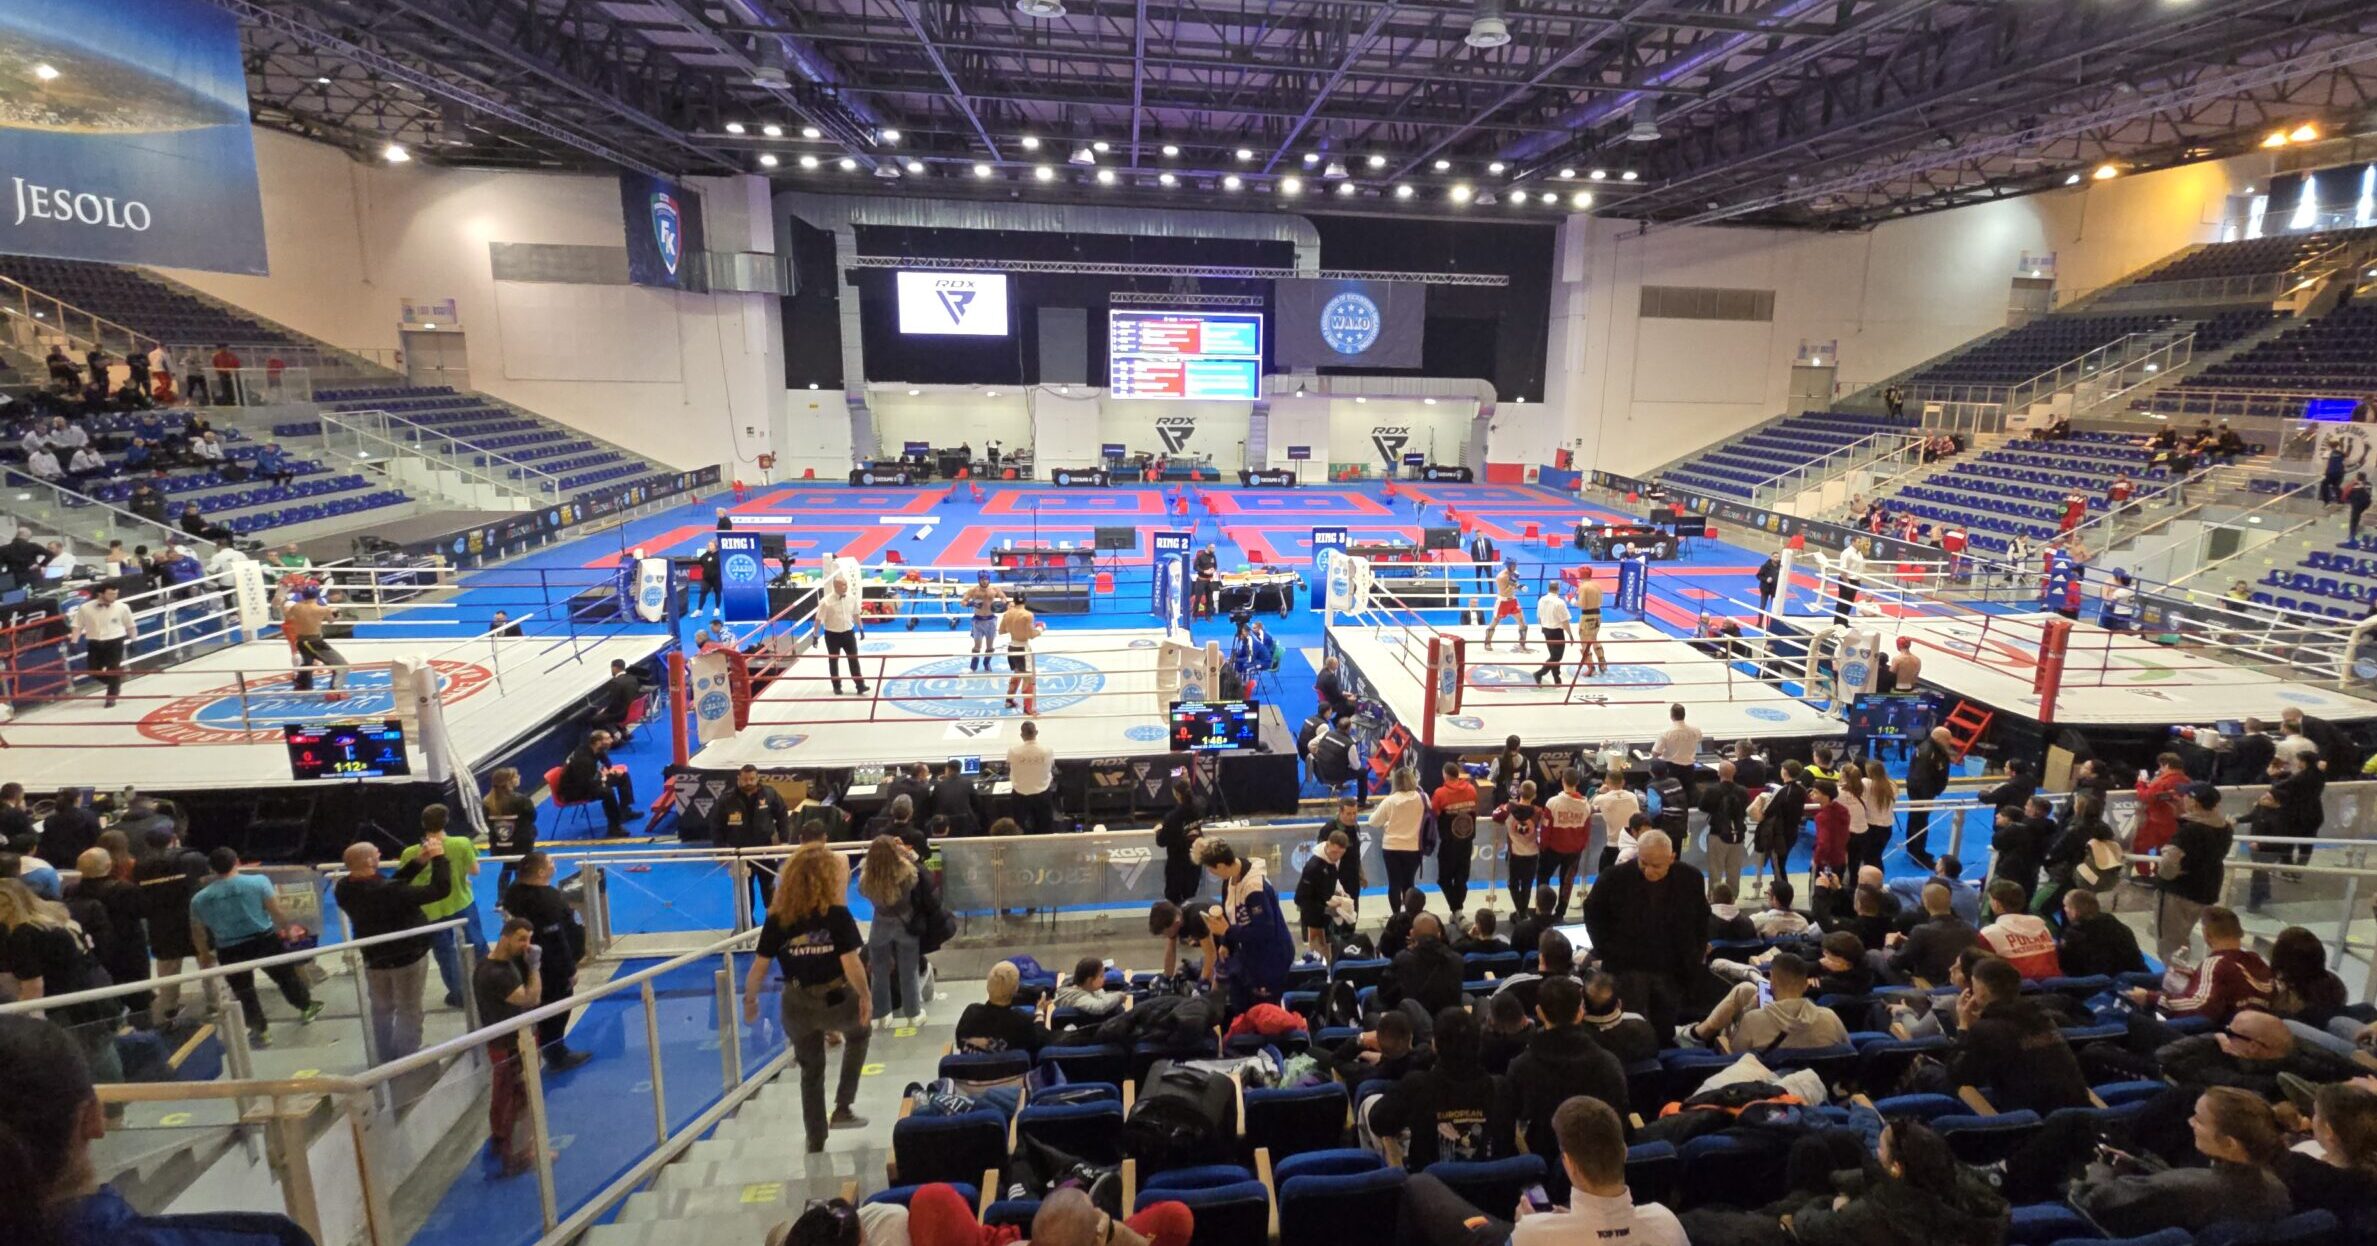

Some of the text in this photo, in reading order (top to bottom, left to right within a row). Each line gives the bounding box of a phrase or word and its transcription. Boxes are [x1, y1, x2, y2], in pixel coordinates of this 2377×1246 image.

[12, 177, 151, 231] JESOLO
[935, 280, 977, 288] RDX
[1156, 417, 1197, 425] RDX
[1371, 427, 1410, 435] RDX
[1156, 538, 1188, 548] RING 2
[1315, 533, 1336, 543] RING
[721, 538, 755, 549] RING 1
[1180, 725, 1248, 736] 0 3
[303, 748, 392, 761] 0 2
[1538, 752, 1574, 760] RDX
[1089, 758, 1129, 767] RDX
